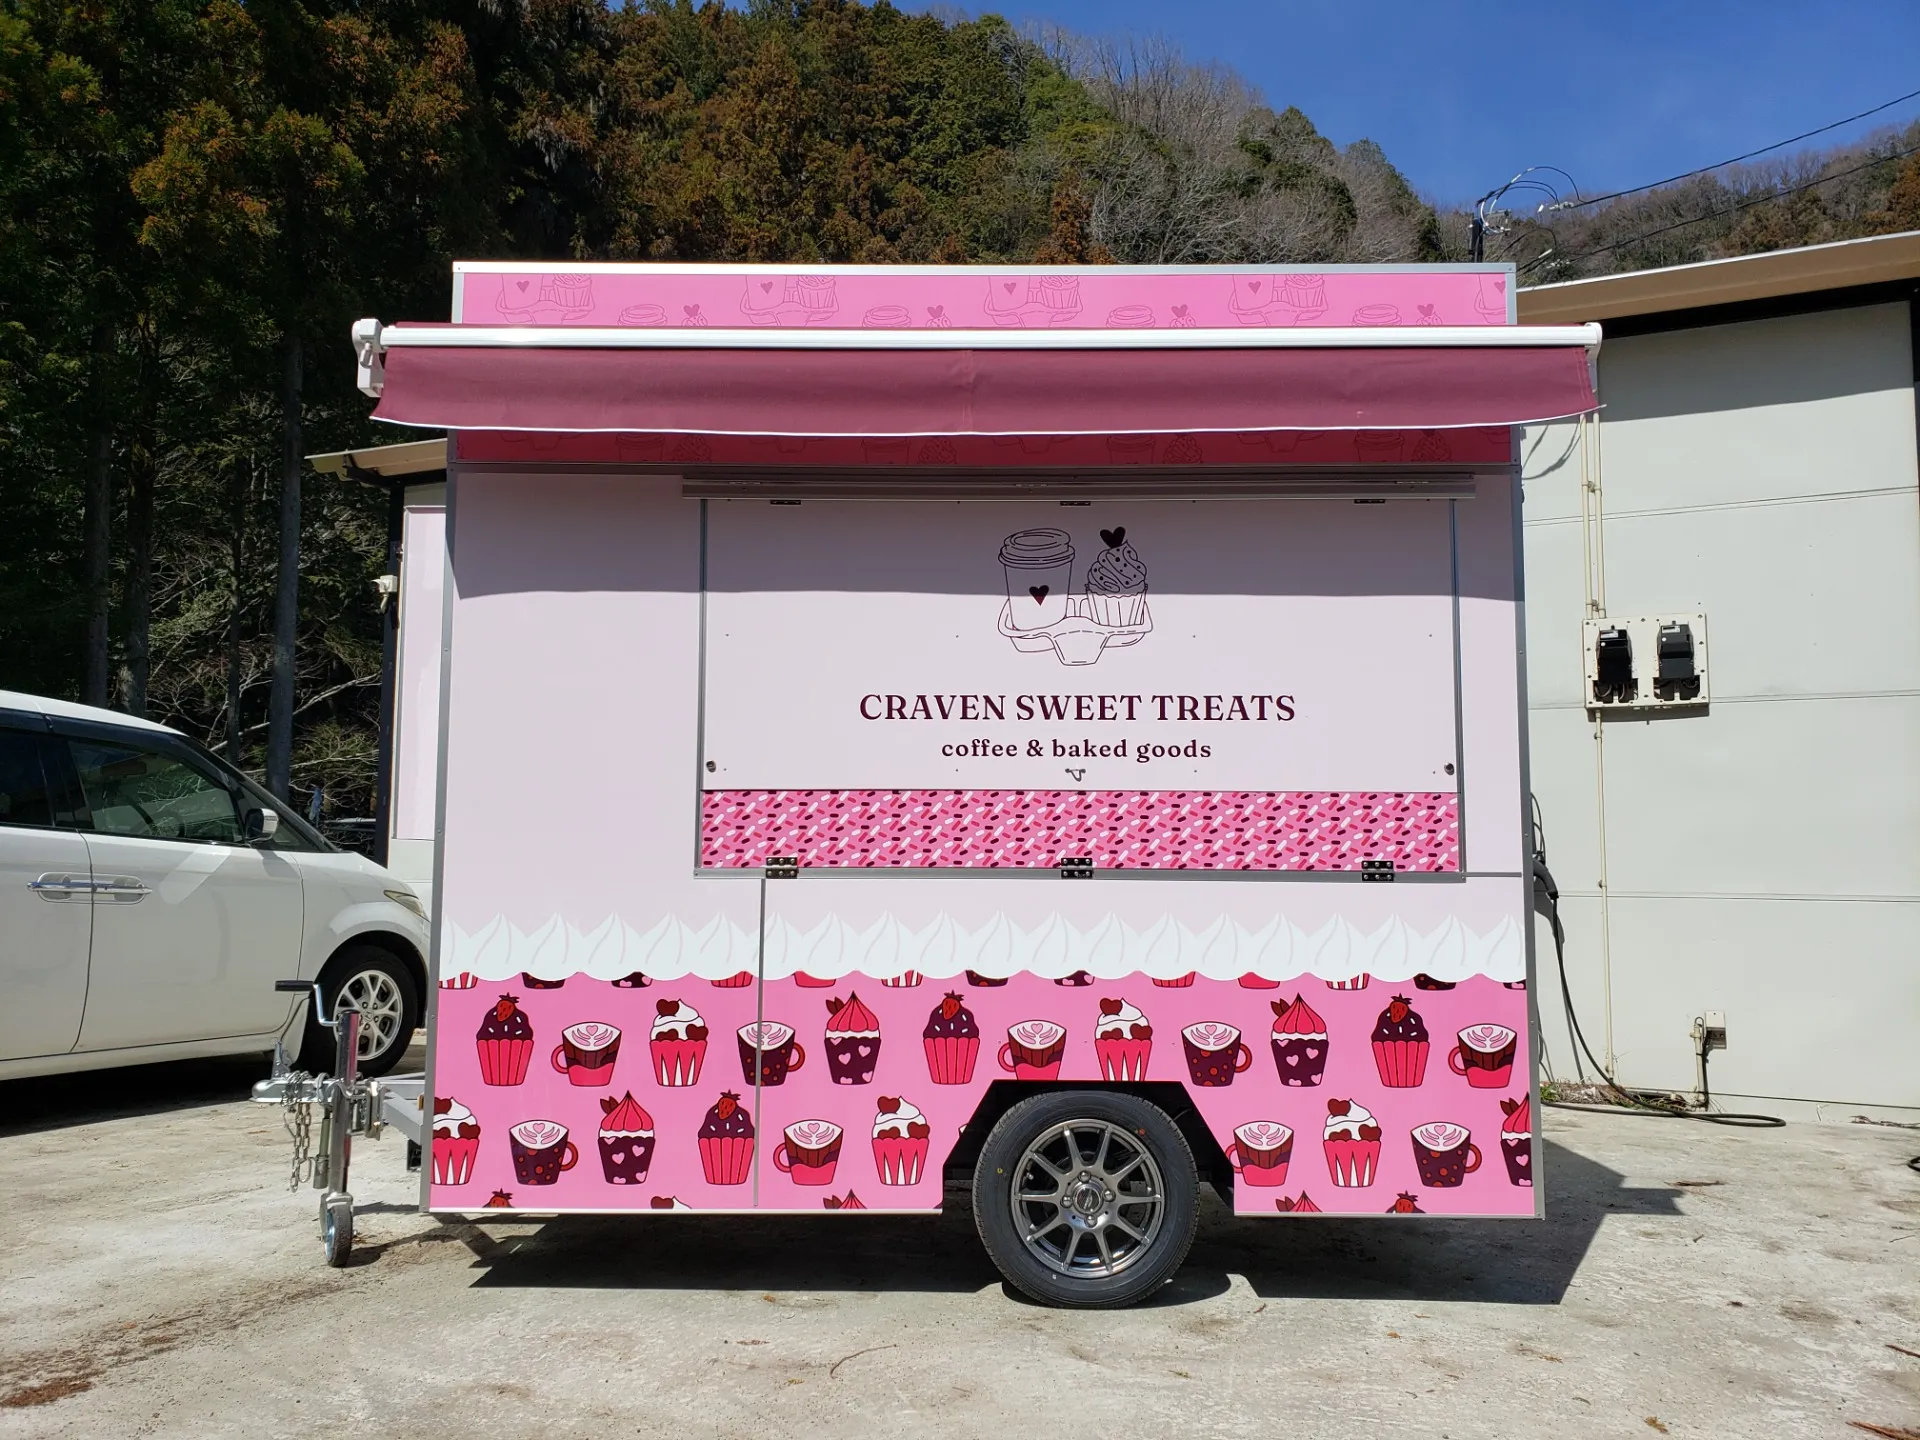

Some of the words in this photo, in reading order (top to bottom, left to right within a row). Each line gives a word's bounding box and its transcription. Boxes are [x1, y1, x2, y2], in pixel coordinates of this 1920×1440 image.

[860, 694, 1007, 721] CRAVEN
[1015, 694, 1143, 721] SWEET
[1151, 694, 1295, 722] TREATS
[941, 738, 1018, 757] coffee
[1026, 739, 1044, 758] &
[1051, 738, 1128, 758] baked
[1136, 739, 1211, 764] goods
